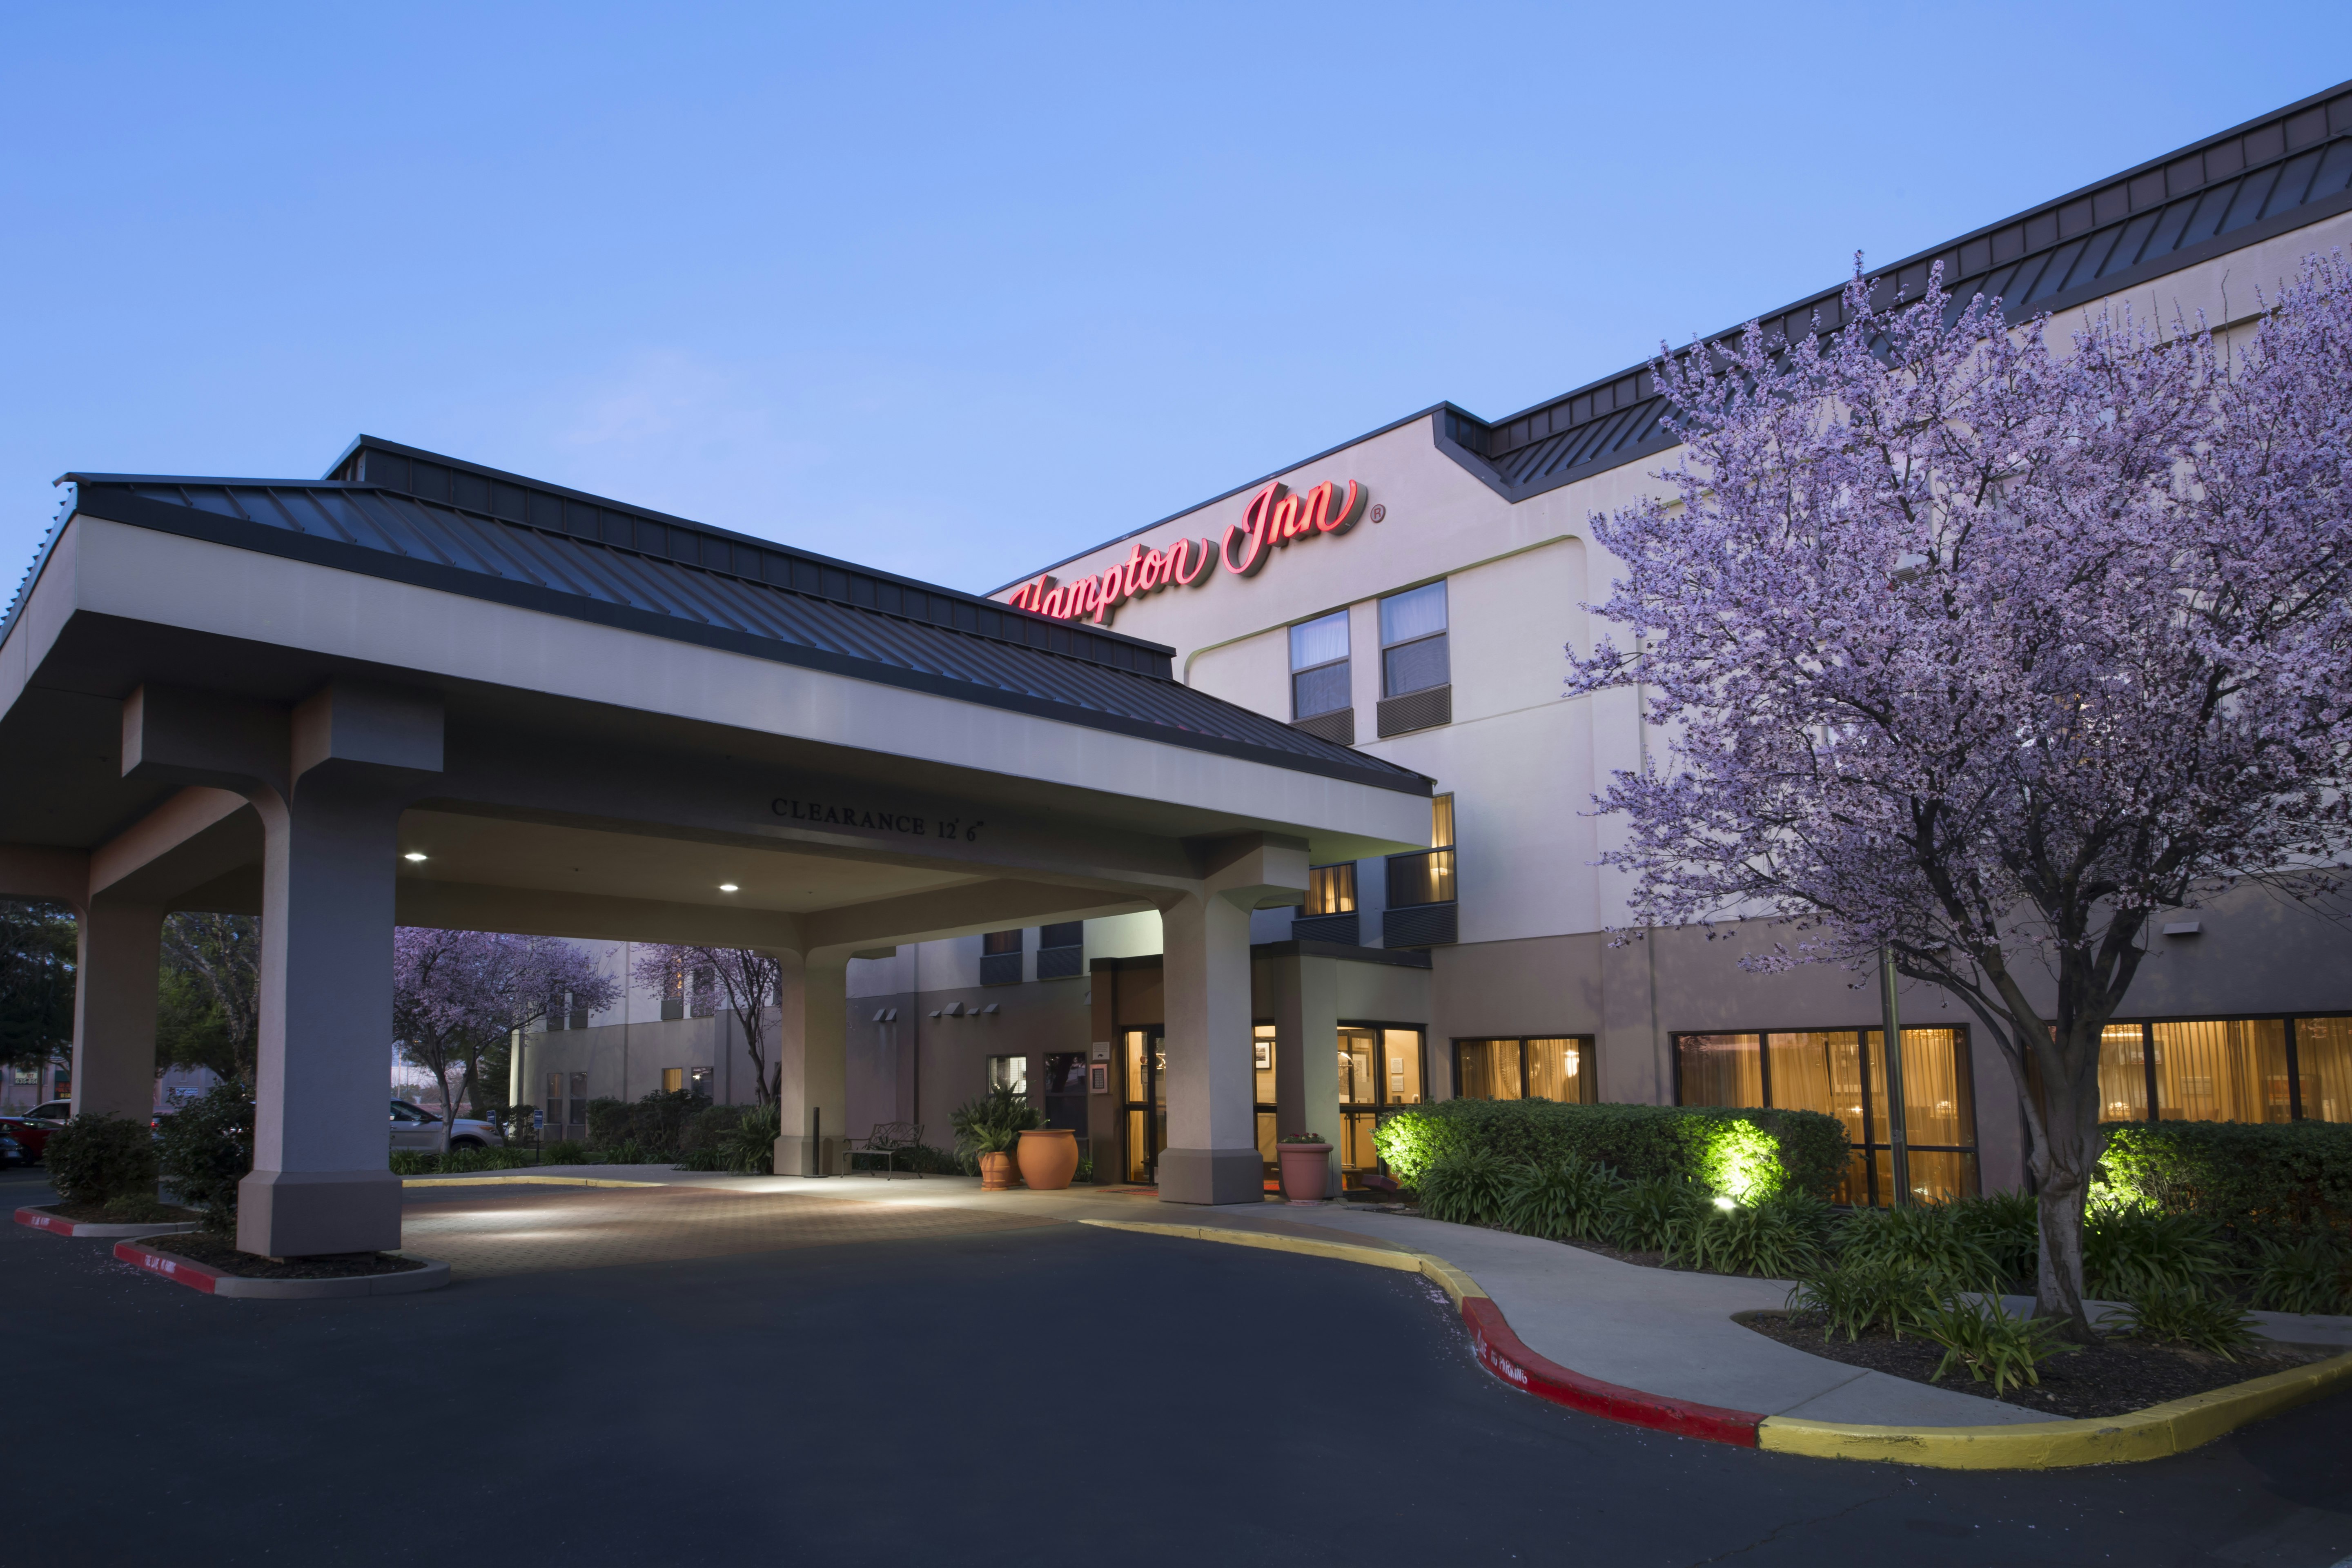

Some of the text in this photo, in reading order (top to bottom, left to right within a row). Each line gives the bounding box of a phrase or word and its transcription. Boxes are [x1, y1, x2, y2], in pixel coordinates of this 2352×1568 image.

[1222, 479, 1366, 576] Inn
[771, 797, 925, 835] CLEARANCE
[1499, 1356, 1528, 1385] PARKING
